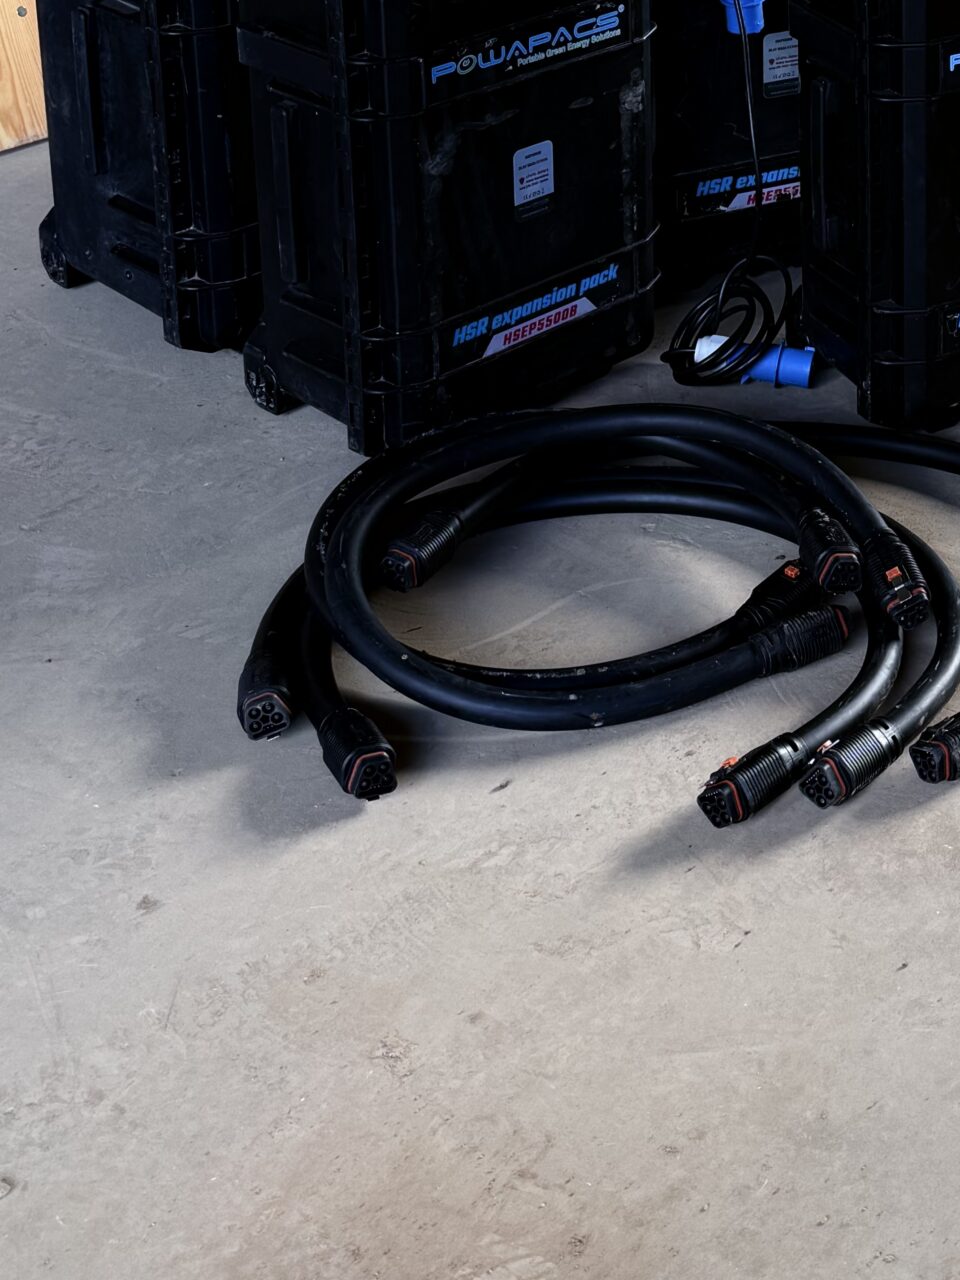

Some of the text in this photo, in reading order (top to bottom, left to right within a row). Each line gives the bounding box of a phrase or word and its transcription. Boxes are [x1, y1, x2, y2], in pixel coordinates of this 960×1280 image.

[517, 29, 621, 67] Portable Green Energy Solutions
[696, 176, 733, 197] HSR
[452, 263, 619, 347] HSR expansion pack
[503, 304, 578, 346] HSEP5500B
